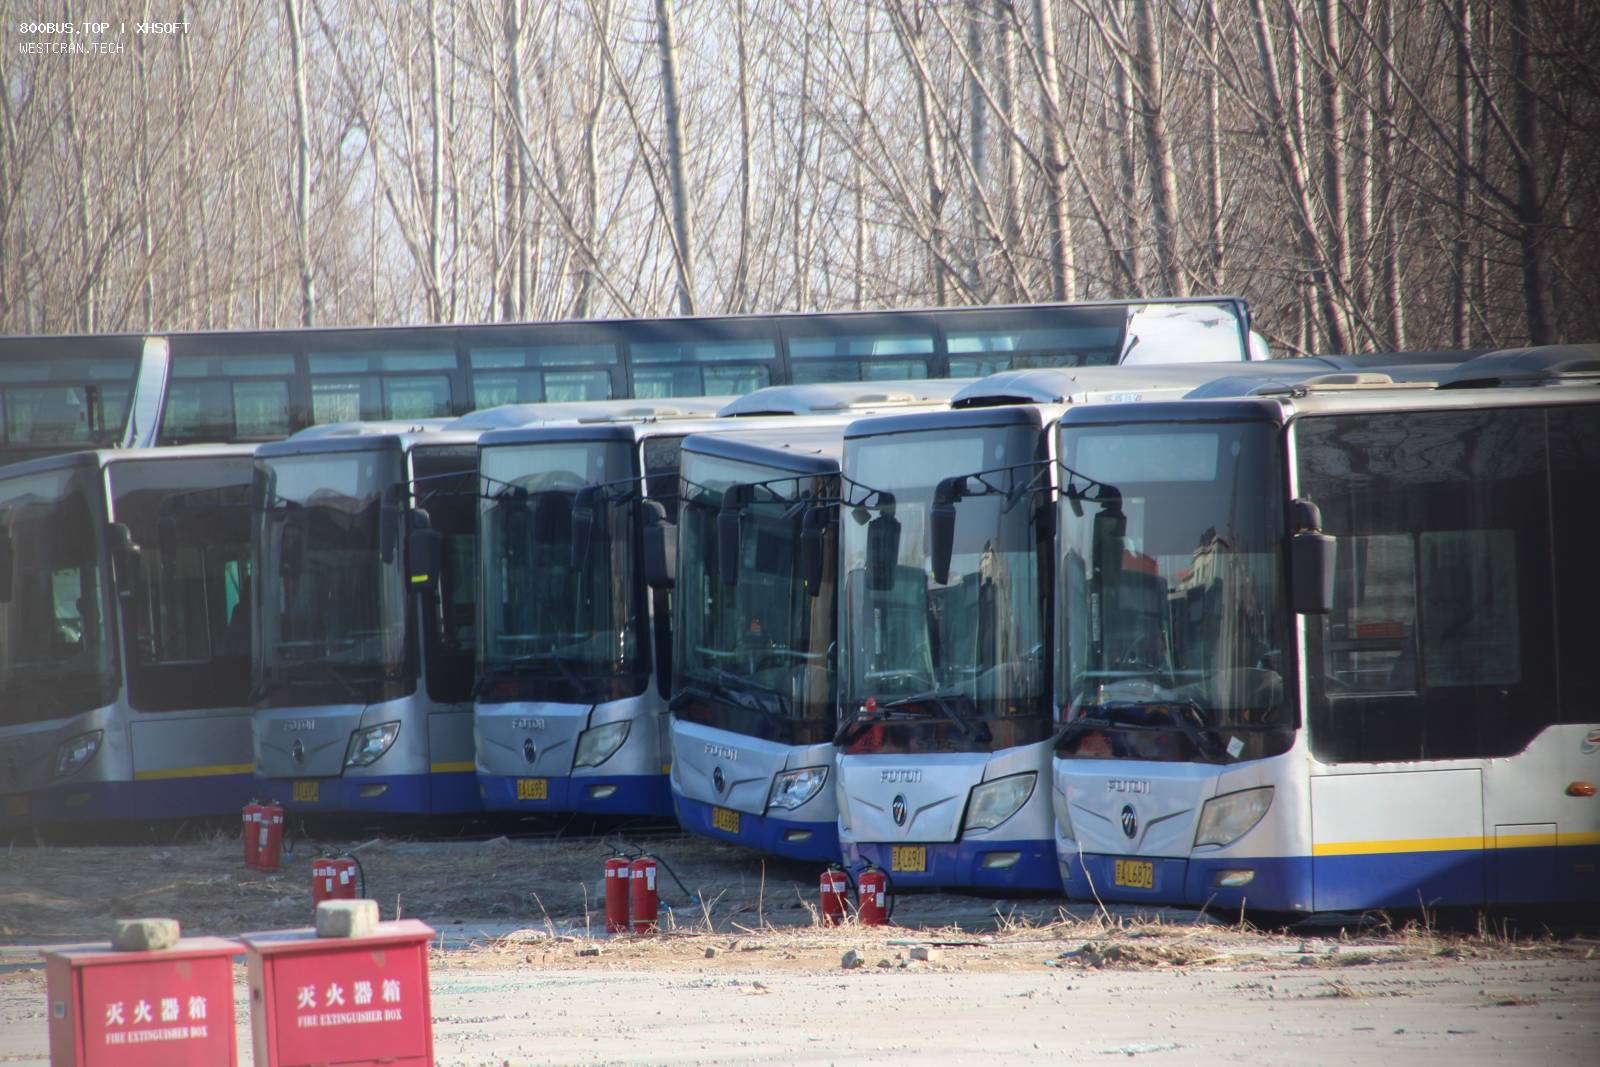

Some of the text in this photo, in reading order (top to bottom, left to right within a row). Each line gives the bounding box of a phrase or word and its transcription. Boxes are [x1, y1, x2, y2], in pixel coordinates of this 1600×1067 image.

[704, 743, 738, 761] FOTON
[881, 769, 922, 783] FOTON
[1107, 779, 1151, 794] FOTON
[297, 978, 401, 1010] 灭火器箱
[104, 995, 207, 1027] 灭火器箱
[298, 1007, 402, 1028] FIRE EXTINGUISHER BOX
[106, 1024, 208, 1046] FIRE EXTINGUISHER BOX
